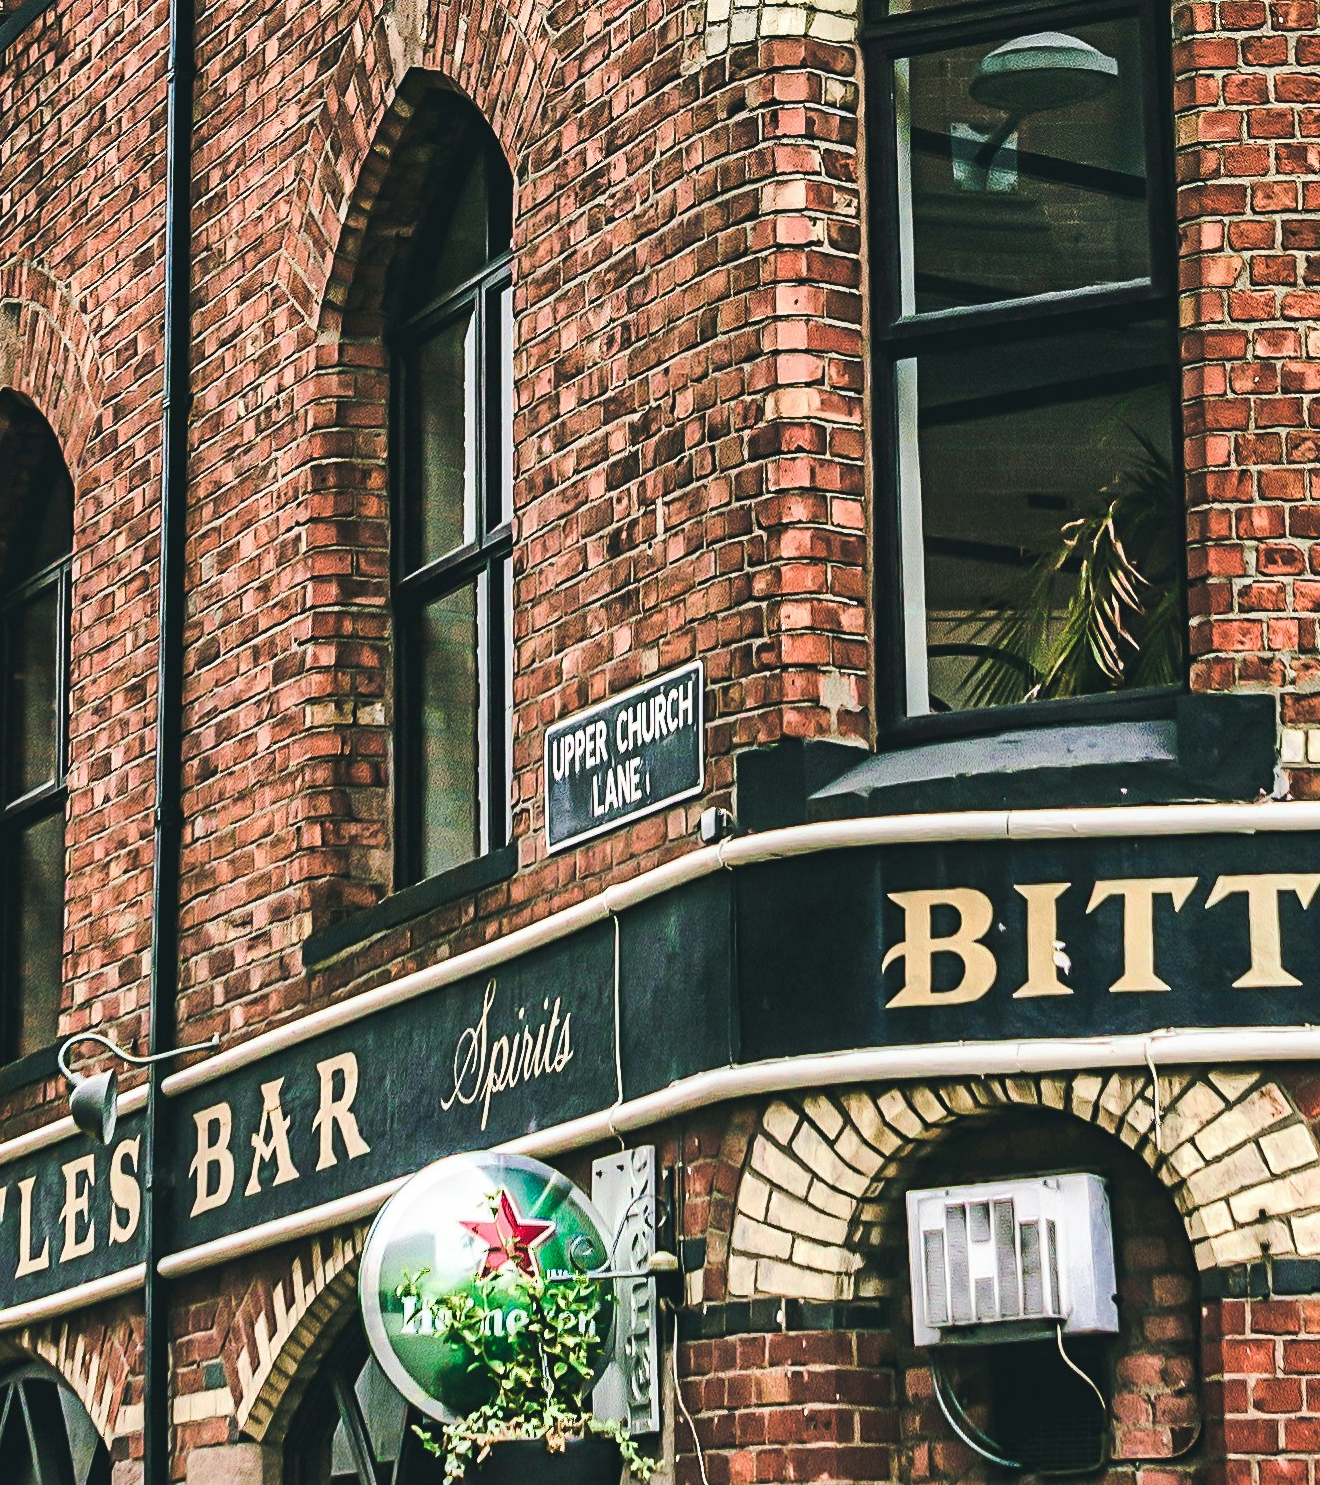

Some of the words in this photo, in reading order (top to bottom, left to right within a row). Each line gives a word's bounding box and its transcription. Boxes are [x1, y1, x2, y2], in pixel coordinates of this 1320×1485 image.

[552, 720, 609, 781] UPPER
[616, 680, 694, 754] CHURCH
[592, 756, 643, 817] LANE
[440, 978, 574, 1131] Spirits
[187, 1050, 373, 1219] BAR
[400, 1295, 597, 1337] Heneen
